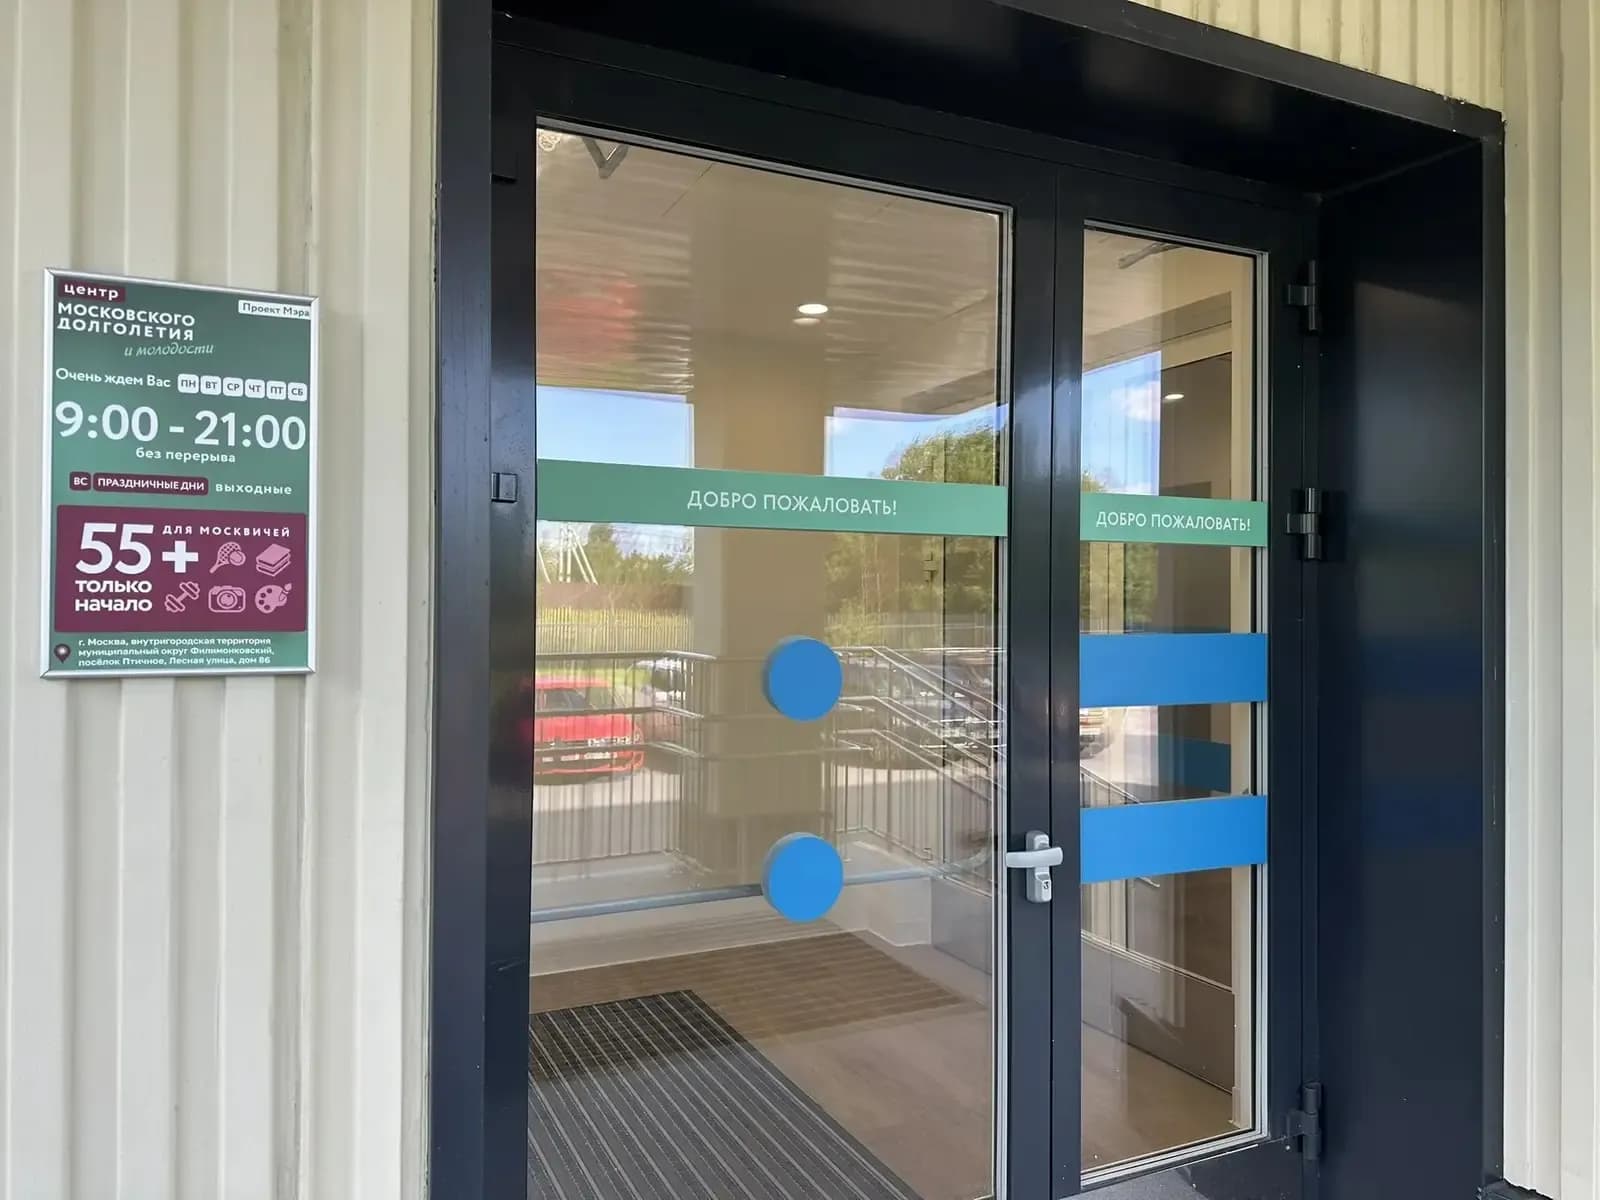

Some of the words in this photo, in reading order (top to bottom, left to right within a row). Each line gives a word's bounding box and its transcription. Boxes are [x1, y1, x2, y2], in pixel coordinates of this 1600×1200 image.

[64, 283, 119, 301] центр
[57, 302, 195, 326] МОСКОВСКОГО
[242, 302, 281, 314] Проект
[283, 306, 310, 317] Мэра
[57, 317, 194, 341] ДОЛГОЛЕТИЯ
[124, 346, 133, 357] и
[135, 342, 214, 357] молодости
[55, 367, 102, 384] Очень
[104, 374, 144, 387] ждем
[147, 375, 171, 388] Вас
[180, 378, 197, 389] ПН
[205, 380, 218, 390] ВТ
[226, 382, 240, 392] СР
[248, 384, 262, 394] ЧТ
[270, 386, 284, 395] ПТ
[291, 387, 304, 397] СБ
[55, 401, 159, 442] 9:00
[194, 410, 306, 450] 21:00
[136, 448, 161, 460] без
[165, 450, 236, 464] перерыва
[73, 476, 89, 487] ВС
[97, 478, 179, 490] ПРАЗДНИЧНЫЕ
[180, 481, 205, 492] ДНИ
[687, 490, 757, 510] ДОБРО
[763, 494, 897, 515] ПОЖАЛОВАТЬ!
[1096, 511, 1147, 527] ДОБРО
[1152, 513, 1251, 531] ПОЖАЛОВАТЬ!
[162, 525, 193, 537] ДЛЯ
[200, 526, 290, 538] МОСКВИЧЕЙ
[75, 579, 152, 593] только
[75, 598, 152, 612] начало
[87, 638, 129, 647] Москва,
[131, 638, 215, 647] внутригородская
[216, 638, 271, 646] территория
[78, 648, 159, 658] муниципальный
[161, 648, 188, 656] округ
[122, 657, 167, 666] Птичное,
[169, 656, 204, 665] Лесная
[206, 657, 237, 666] улица,
[238, 657, 257, 665] дом
